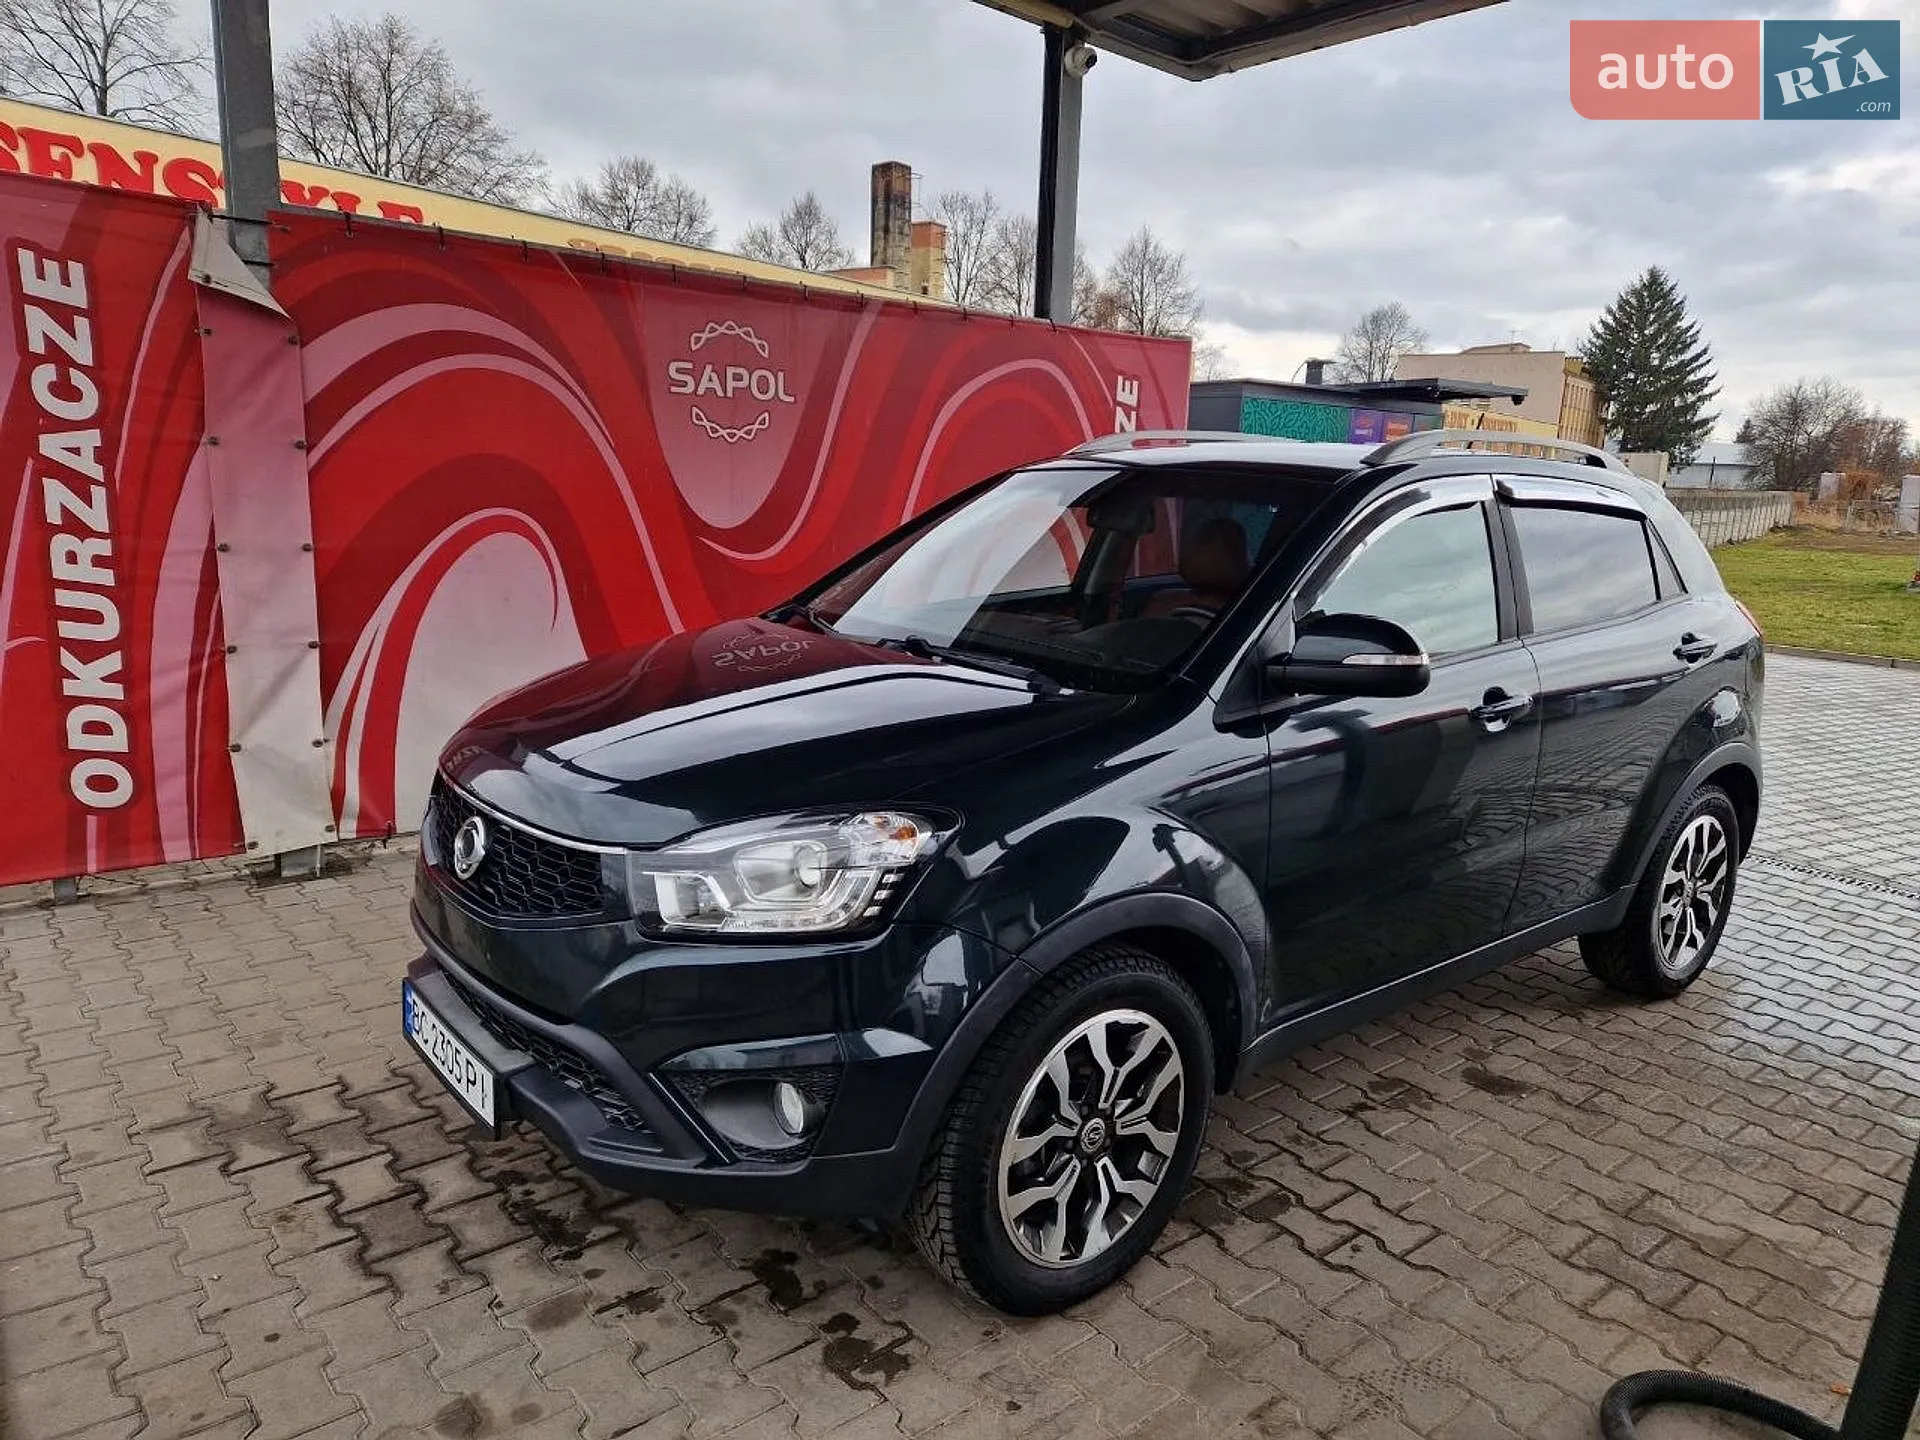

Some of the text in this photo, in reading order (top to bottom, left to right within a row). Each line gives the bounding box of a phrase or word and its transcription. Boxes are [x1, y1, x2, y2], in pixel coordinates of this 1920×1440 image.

[668, 360, 796, 403] SAPOL
[17, 247, 134, 809] ODKURZACZE
[431, 1022, 462, 1085] 2305
[465, 1058, 486, 1109] PI
